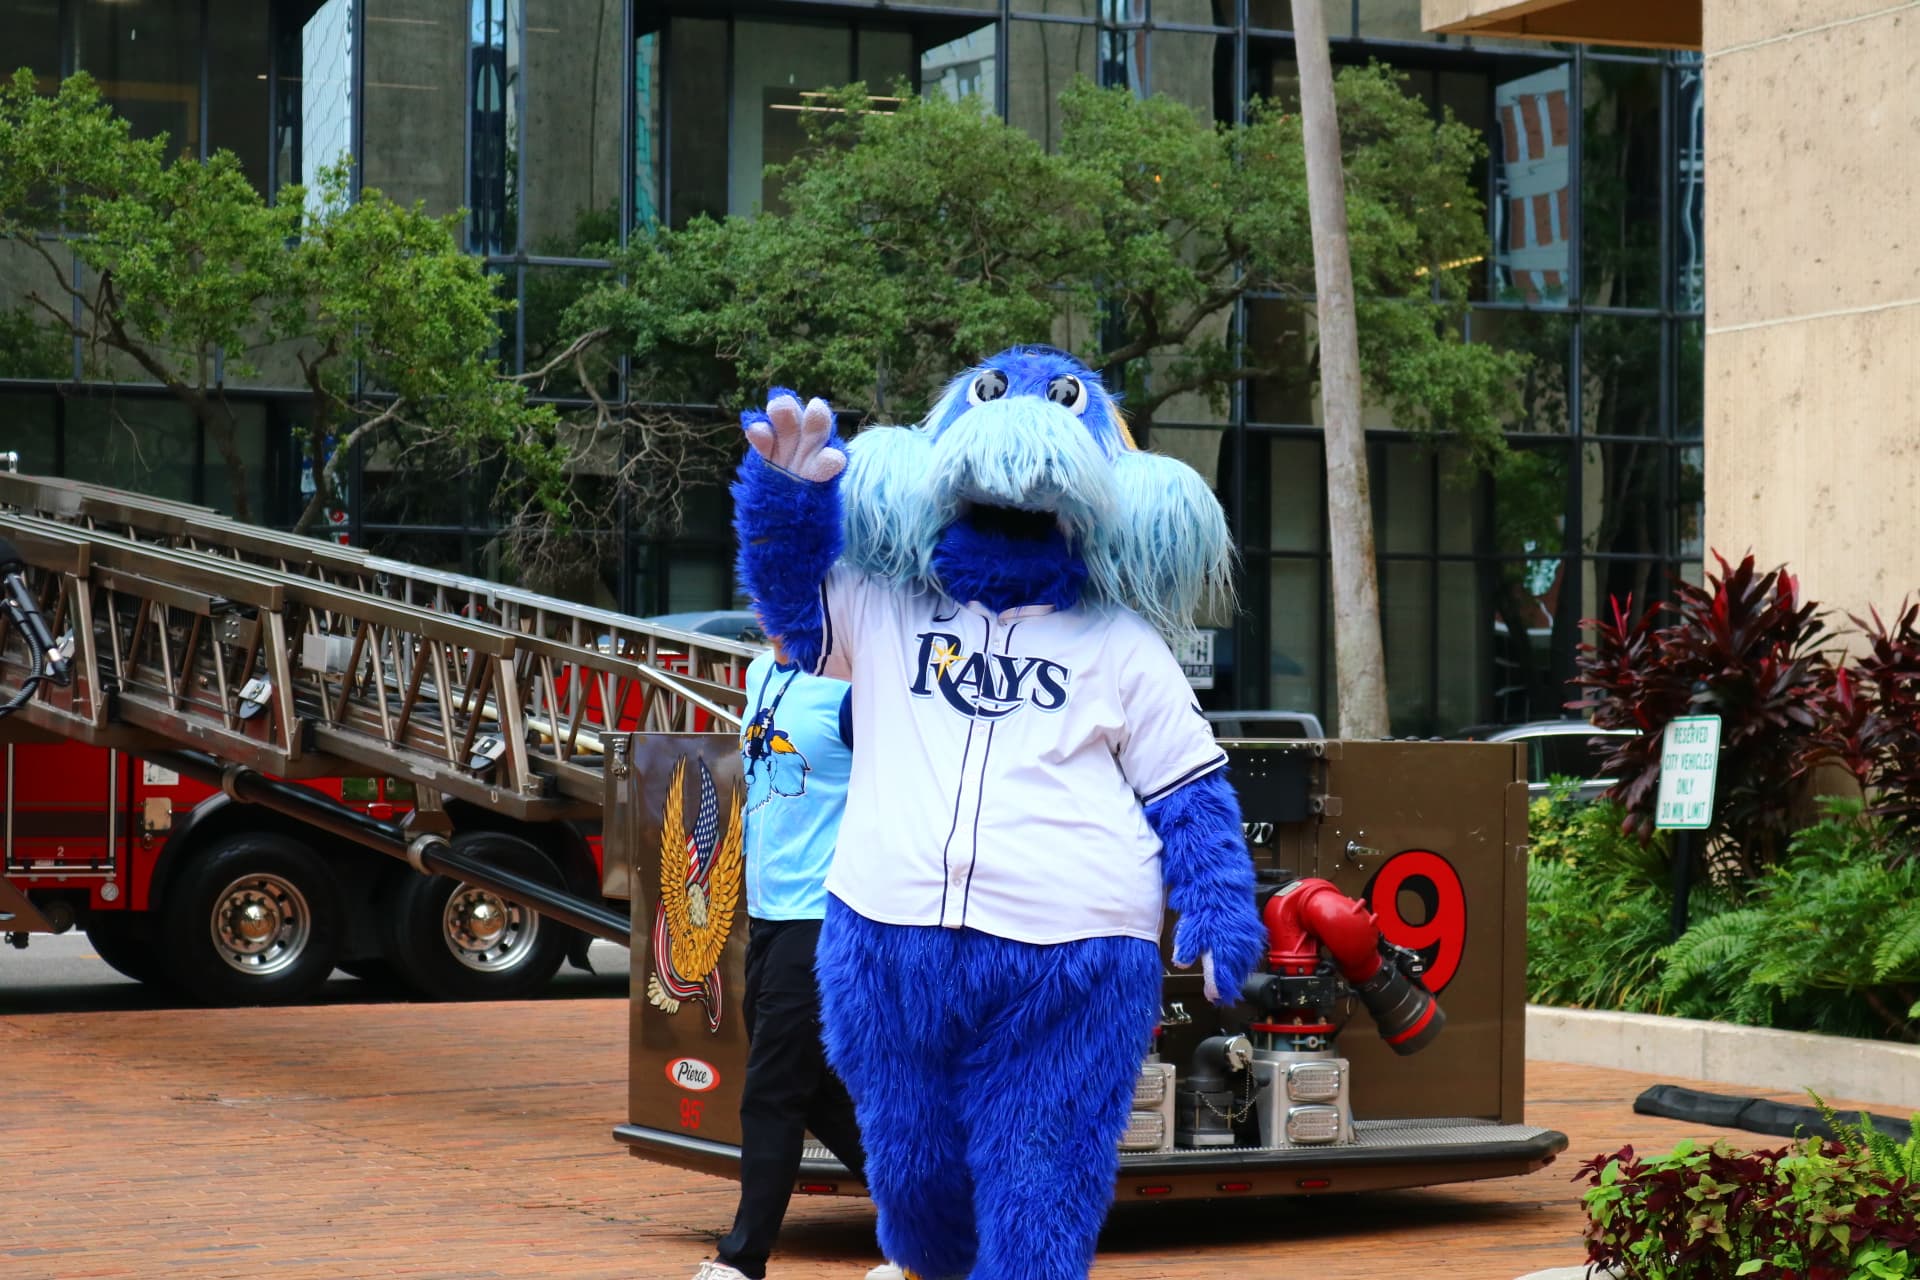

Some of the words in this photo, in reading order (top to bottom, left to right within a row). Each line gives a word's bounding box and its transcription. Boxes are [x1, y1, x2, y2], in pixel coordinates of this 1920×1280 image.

[910, 632, 1069, 718] RAYS
[1674, 726, 1709, 744] RESERVED
[1664, 753, 1678, 770] CITY
[1681, 753, 1713, 770] VEHICLES
[1676, 778, 1694, 795] ONLY
[1687, 801, 1705, 819] LIMIT
[1370, 849, 1467, 995] 9
[677, 1061, 707, 1083] Pierce
